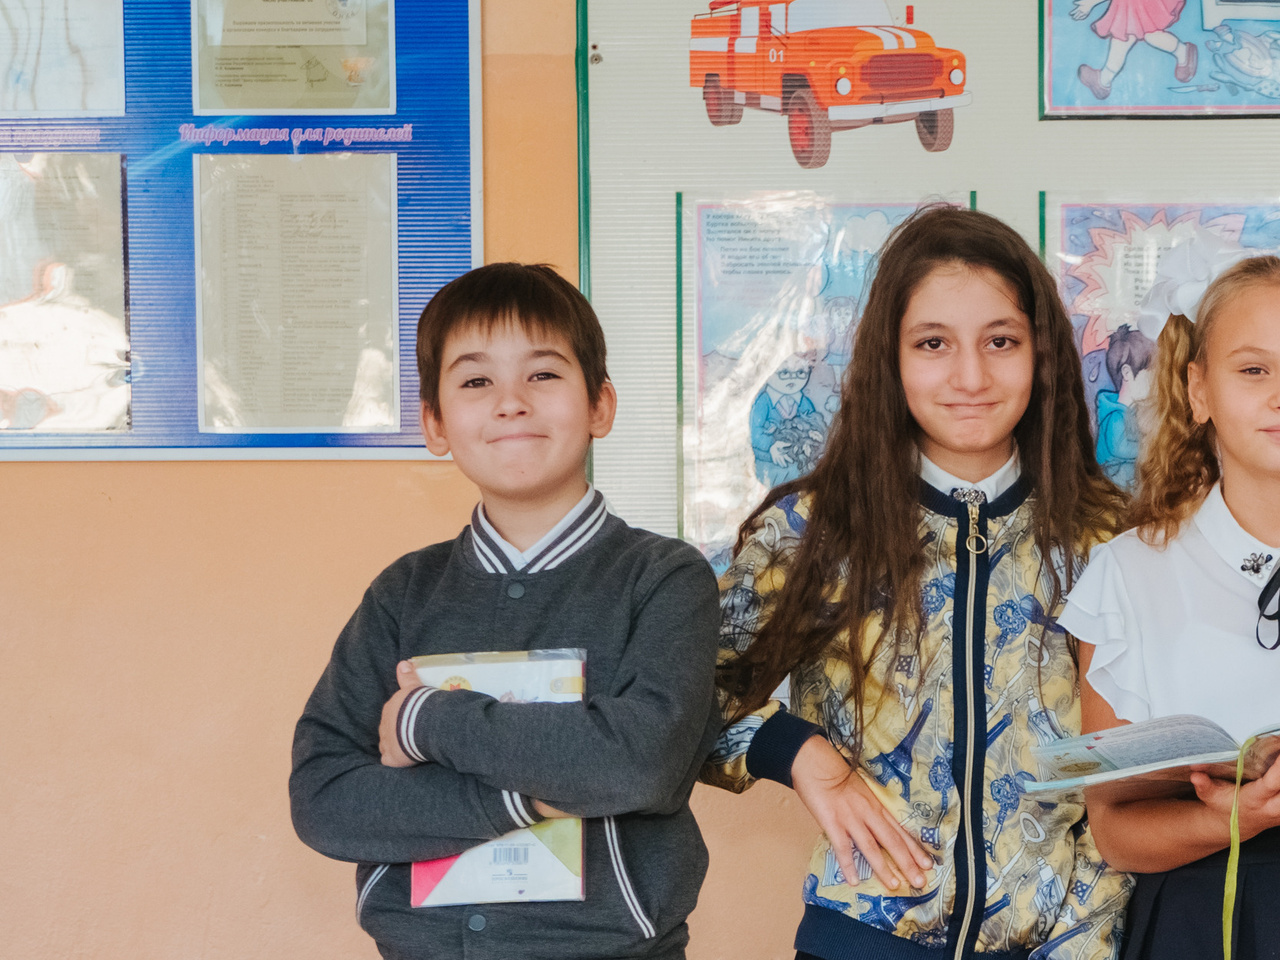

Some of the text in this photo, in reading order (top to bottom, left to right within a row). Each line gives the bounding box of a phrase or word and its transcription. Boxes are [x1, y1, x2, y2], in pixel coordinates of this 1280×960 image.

[769, 48, 784, 63] 01
[179, 123, 413, 147] Информация для родителей
